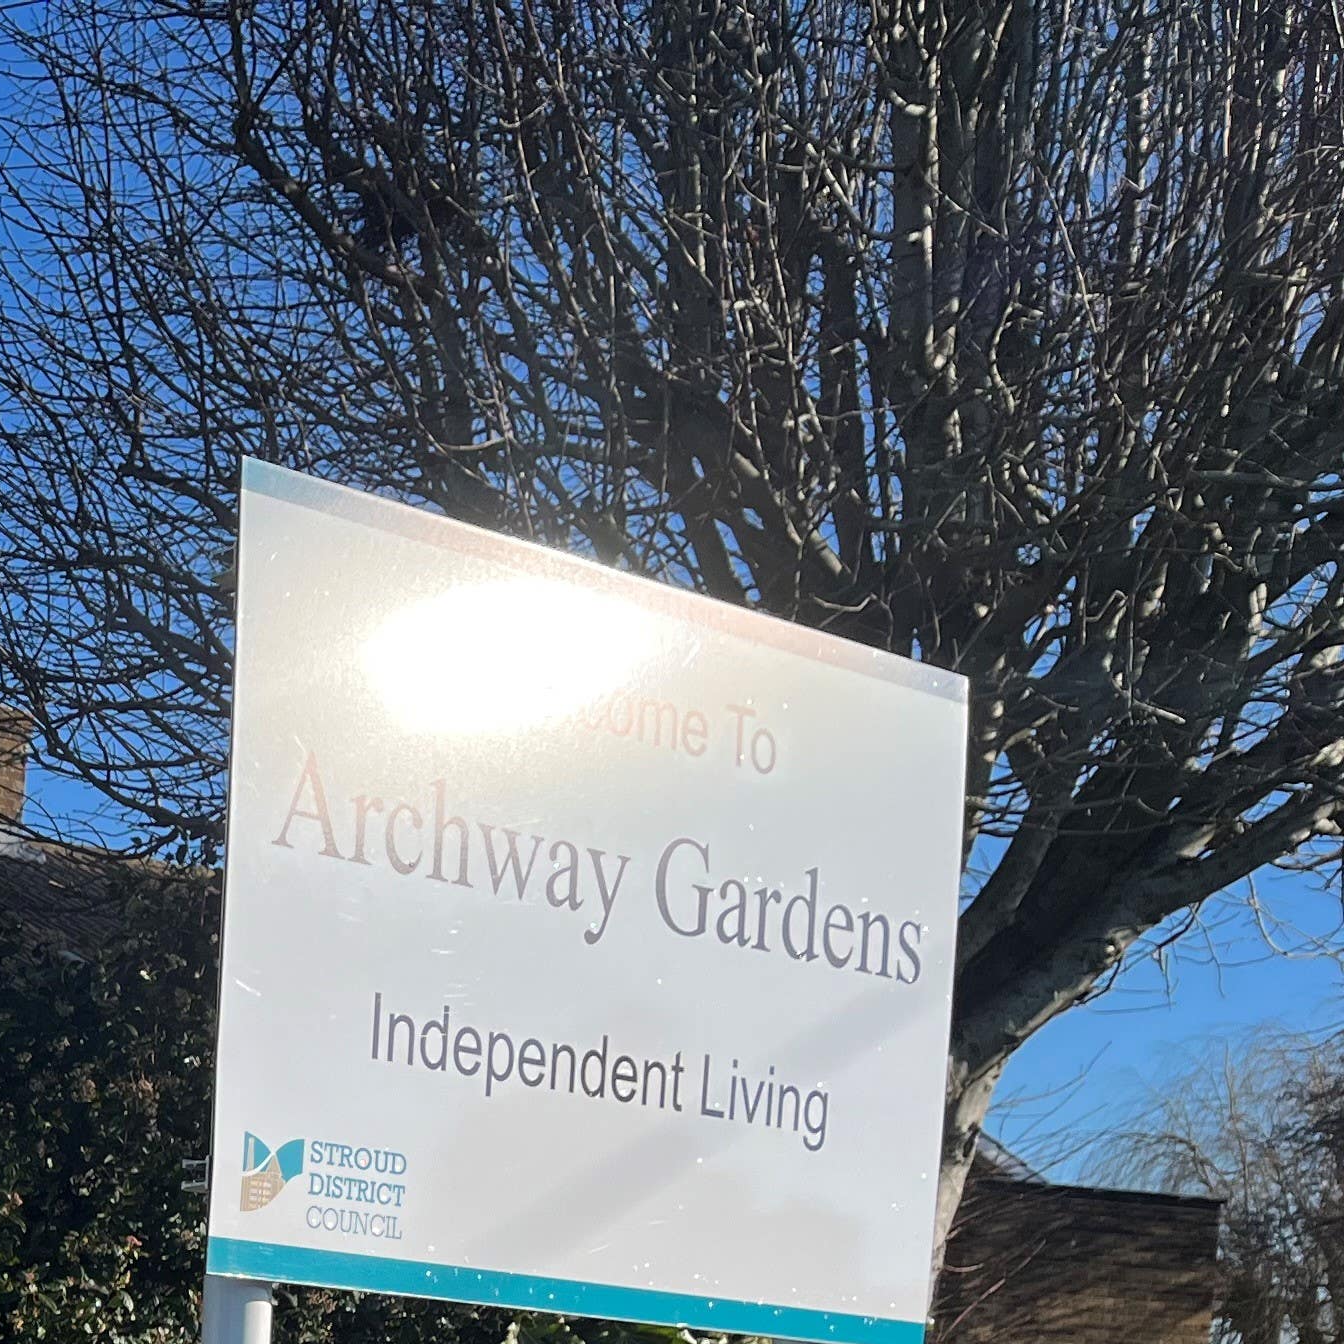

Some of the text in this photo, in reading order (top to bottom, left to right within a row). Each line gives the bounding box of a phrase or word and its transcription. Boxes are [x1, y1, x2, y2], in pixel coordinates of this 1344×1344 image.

[726, 703, 777, 775] To
[271, 749, 924, 985] Archway Gardens
[371, 991, 829, 1152] Independent Living
[310, 1140, 407, 1175] STROUD
[307, 1172, 406, 1207] DISTRICT
[306, 1205, 403, 1240] COUNCIL
